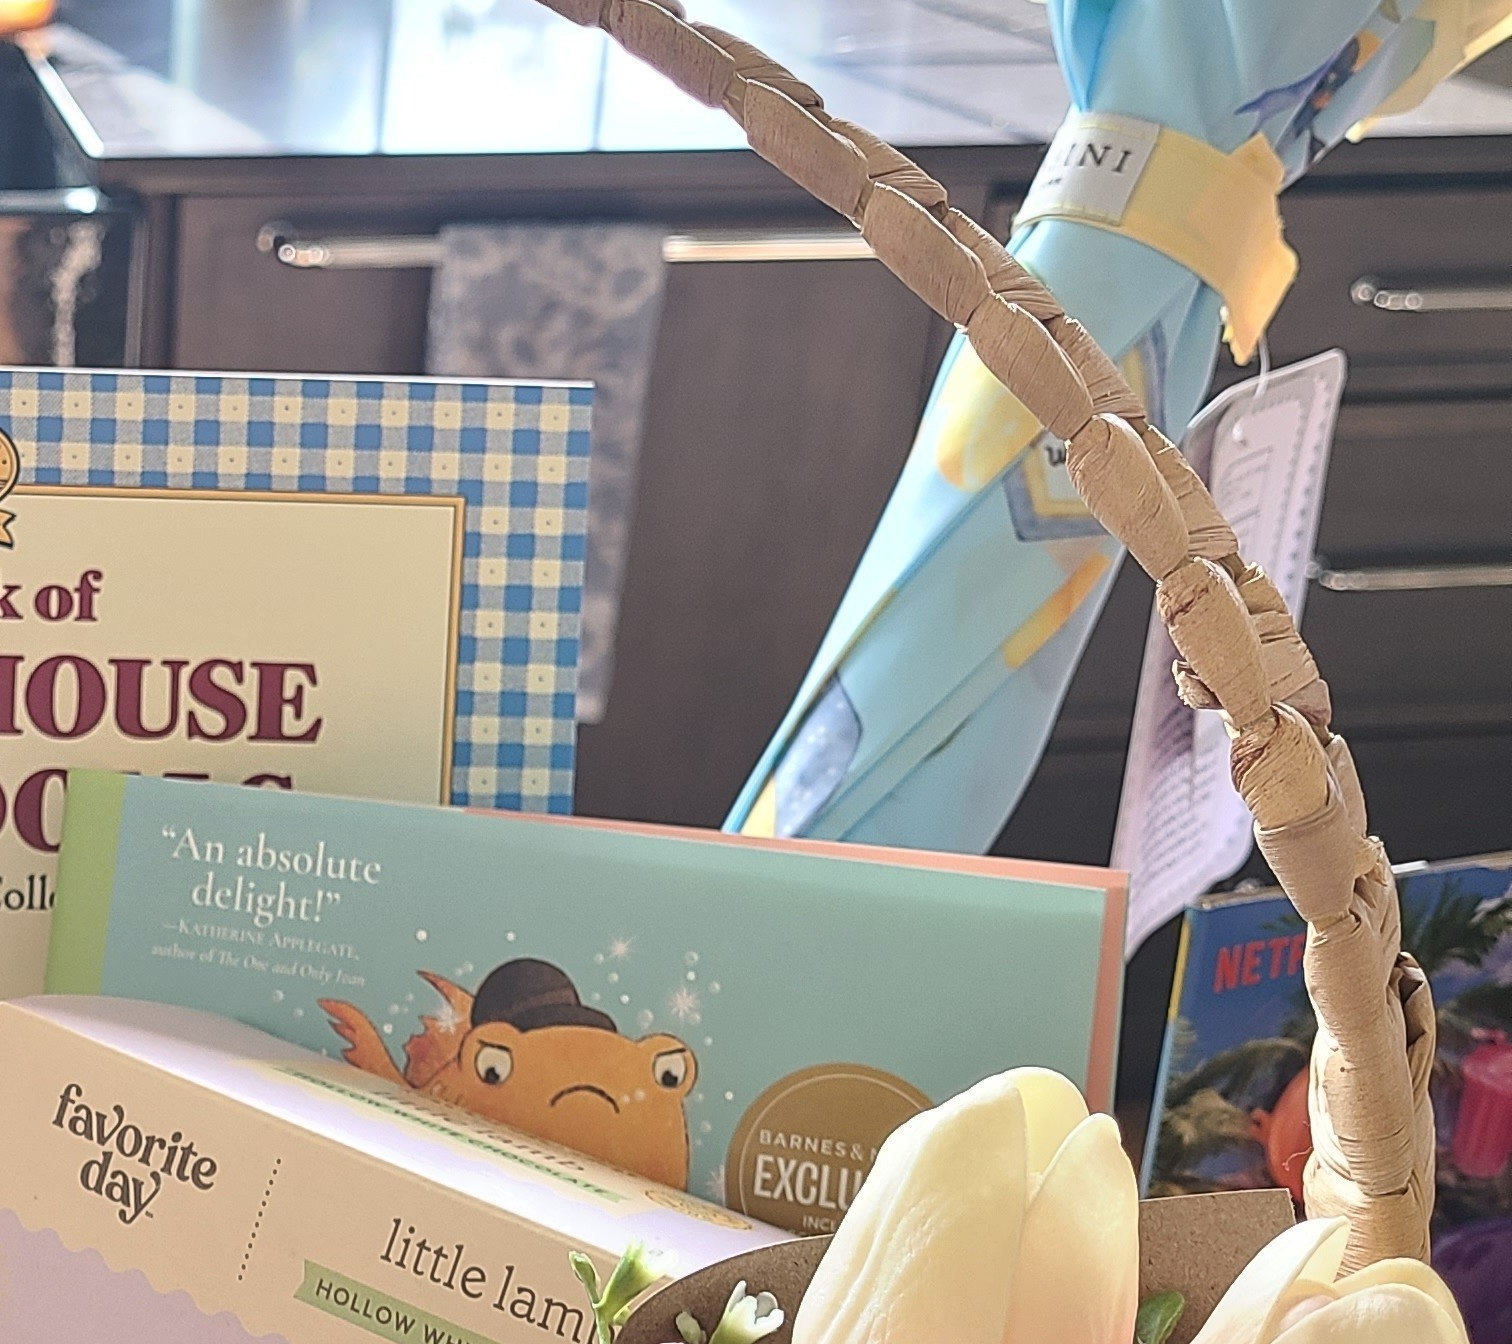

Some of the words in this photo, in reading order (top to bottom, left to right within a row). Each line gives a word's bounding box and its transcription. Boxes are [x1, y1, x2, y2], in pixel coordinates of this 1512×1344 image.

[34, 568, 103, 623] of
[236, 831, 383, 885] absolute
[51, 1082, 218, 1191] favorite
[379, 1217, 487, 1299] little
[315, 1277, 417, 1336] HOLLOW
